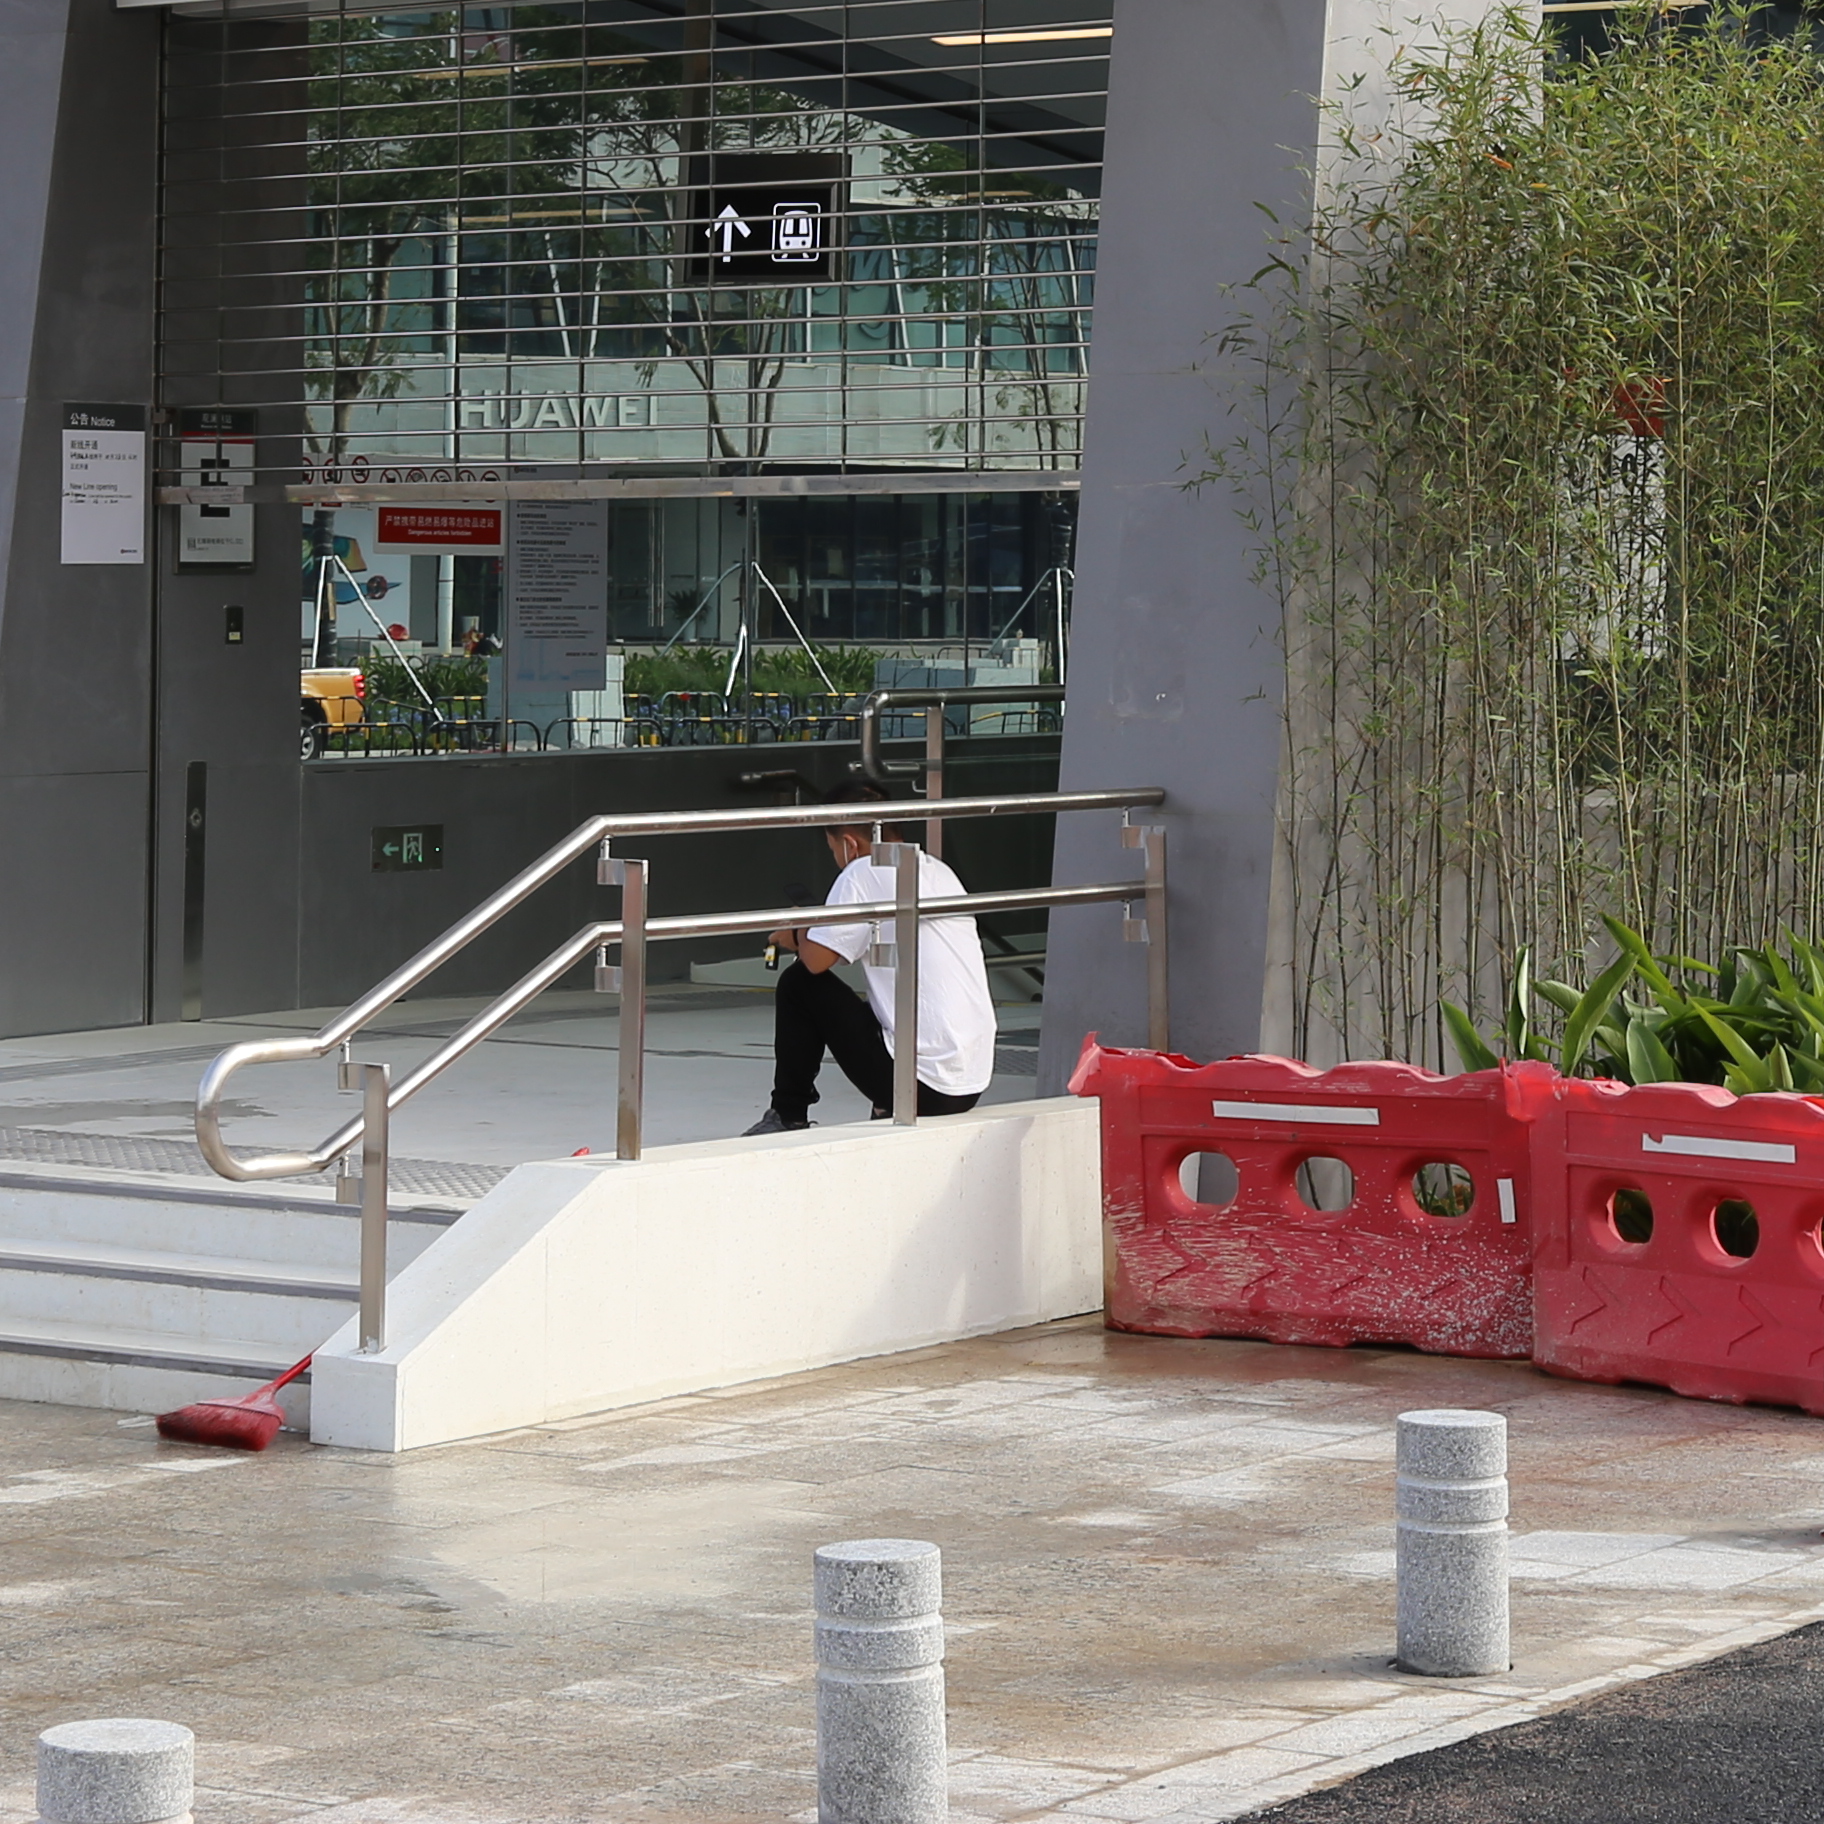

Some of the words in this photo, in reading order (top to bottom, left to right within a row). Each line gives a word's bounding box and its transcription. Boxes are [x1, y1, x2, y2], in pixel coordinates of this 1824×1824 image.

[70, 412, 89, 426] 公告
[90, 416, 116, 428] Notice
[460, 387, 660, 428] HUAWEI
